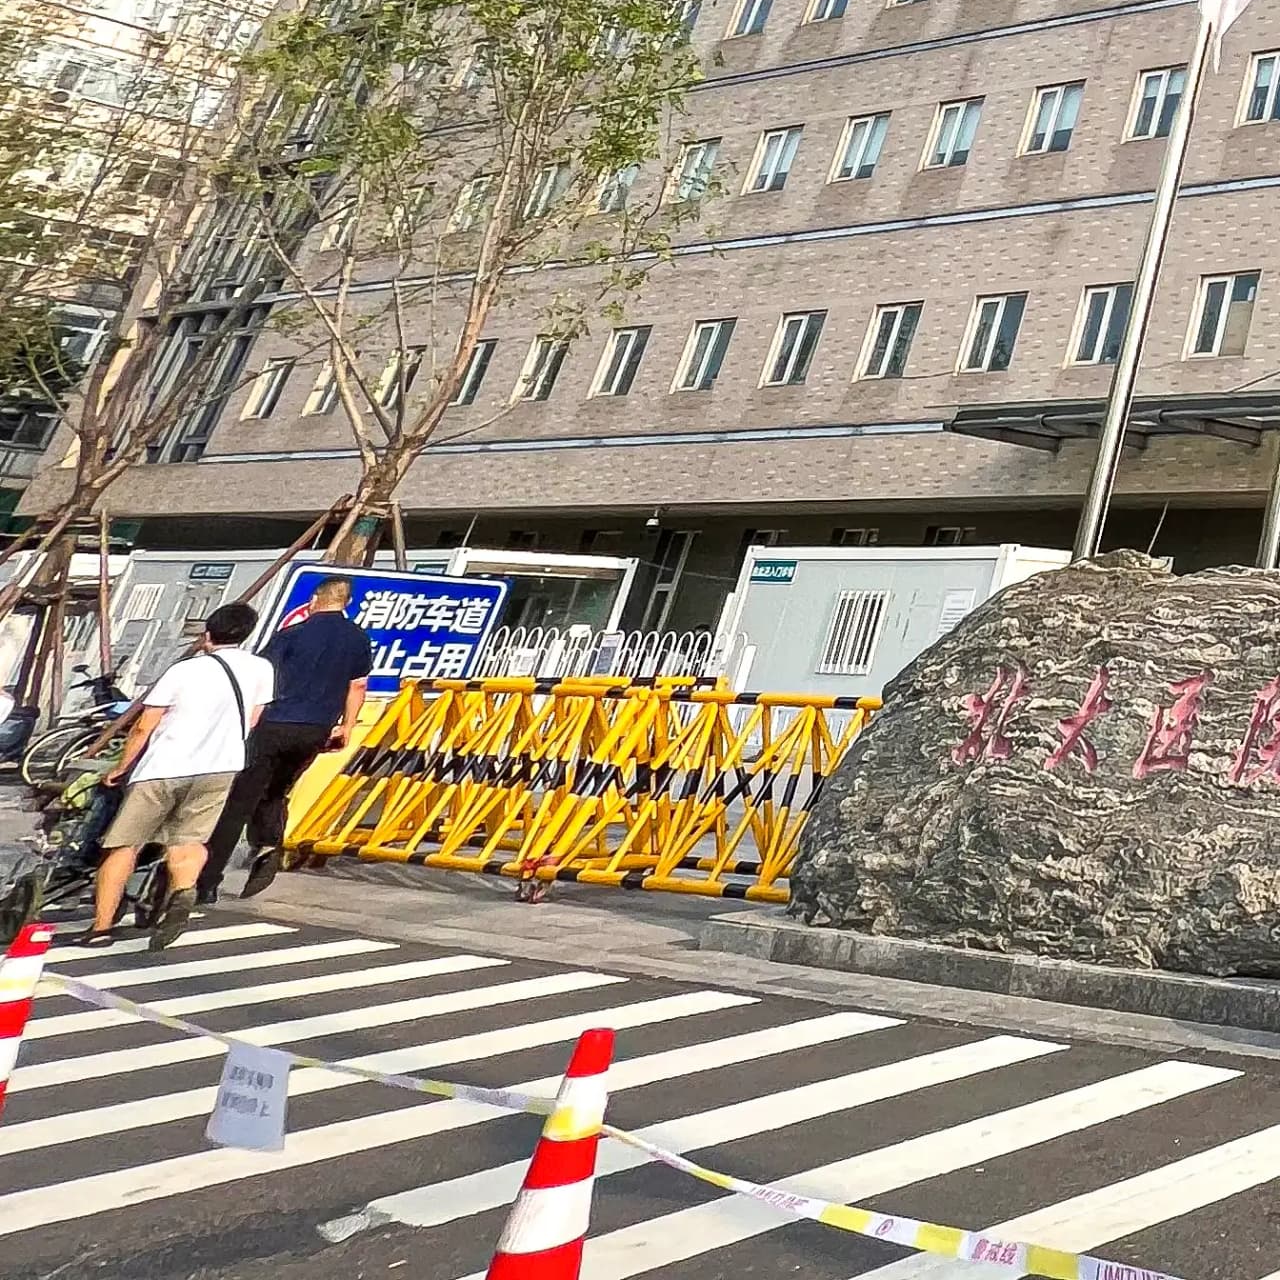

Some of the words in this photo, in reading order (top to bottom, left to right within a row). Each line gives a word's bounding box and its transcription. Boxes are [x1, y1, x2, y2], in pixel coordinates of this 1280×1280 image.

[354, 590, 492, 634] 消防车道
[368, 639, 473, 678] 止占用
